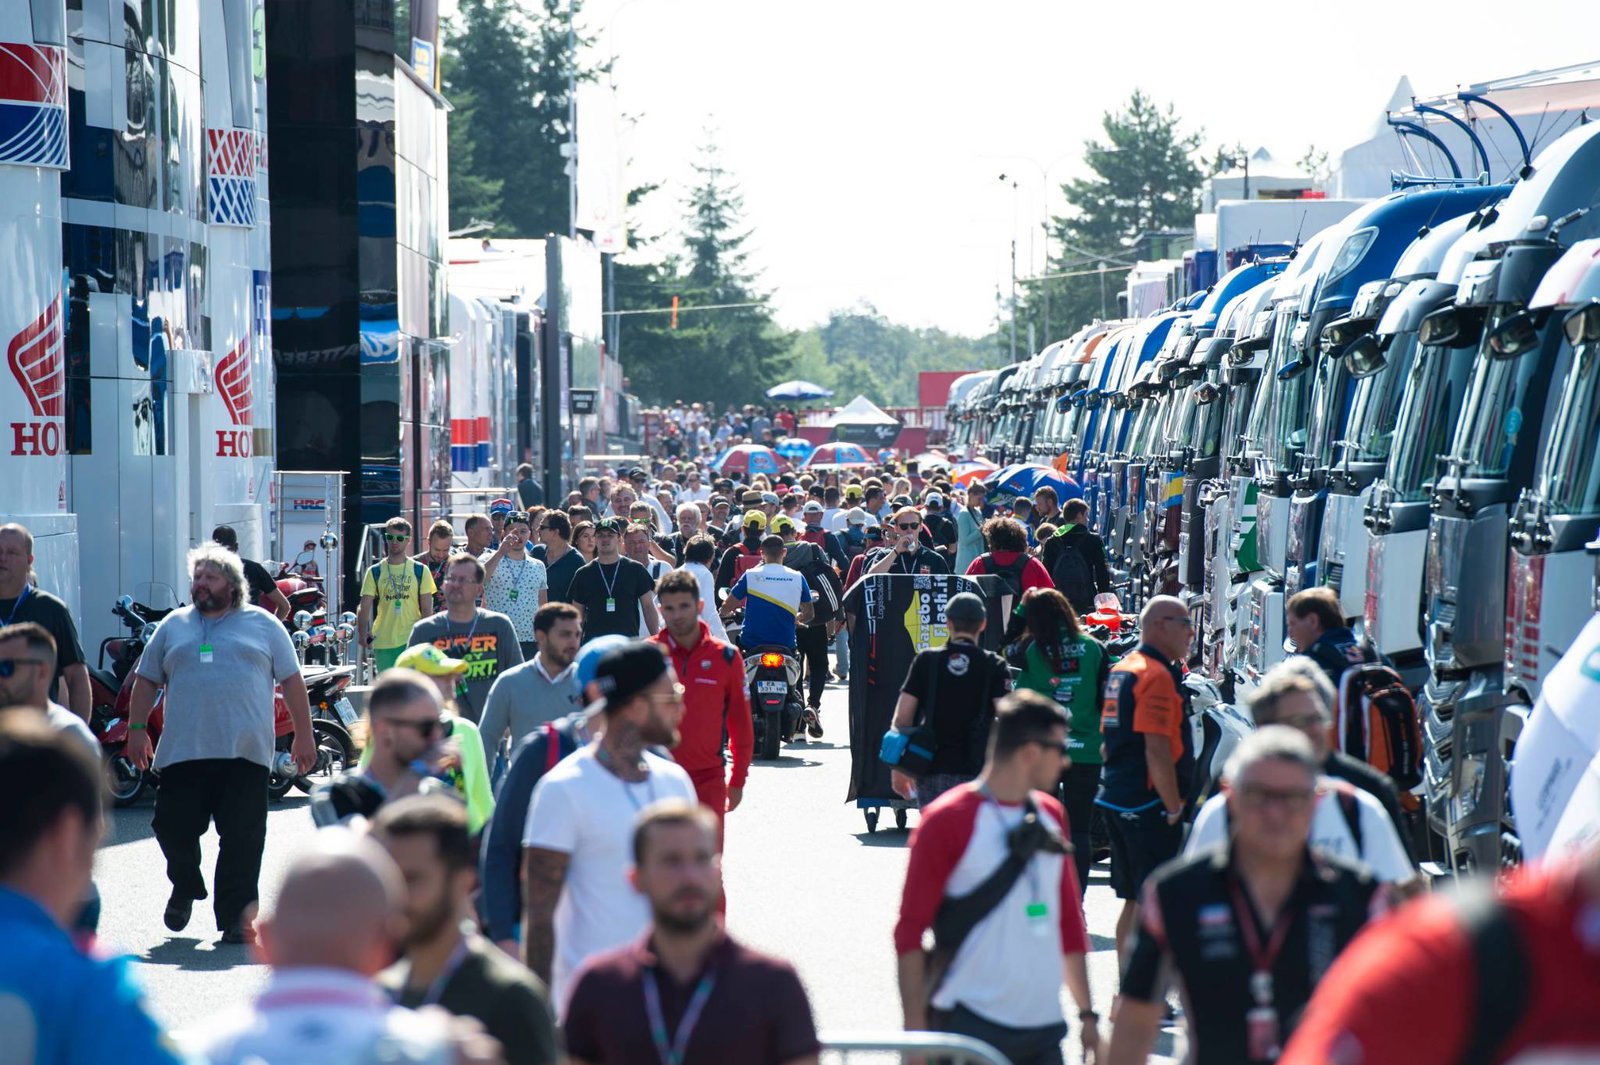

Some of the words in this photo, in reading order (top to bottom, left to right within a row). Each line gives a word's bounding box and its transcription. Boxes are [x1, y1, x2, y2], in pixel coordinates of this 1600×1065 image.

[216, 430, 252, 458] HO
[294, 499, 325, 510] HRC
[917, 593, 930, 651] Gazebo
